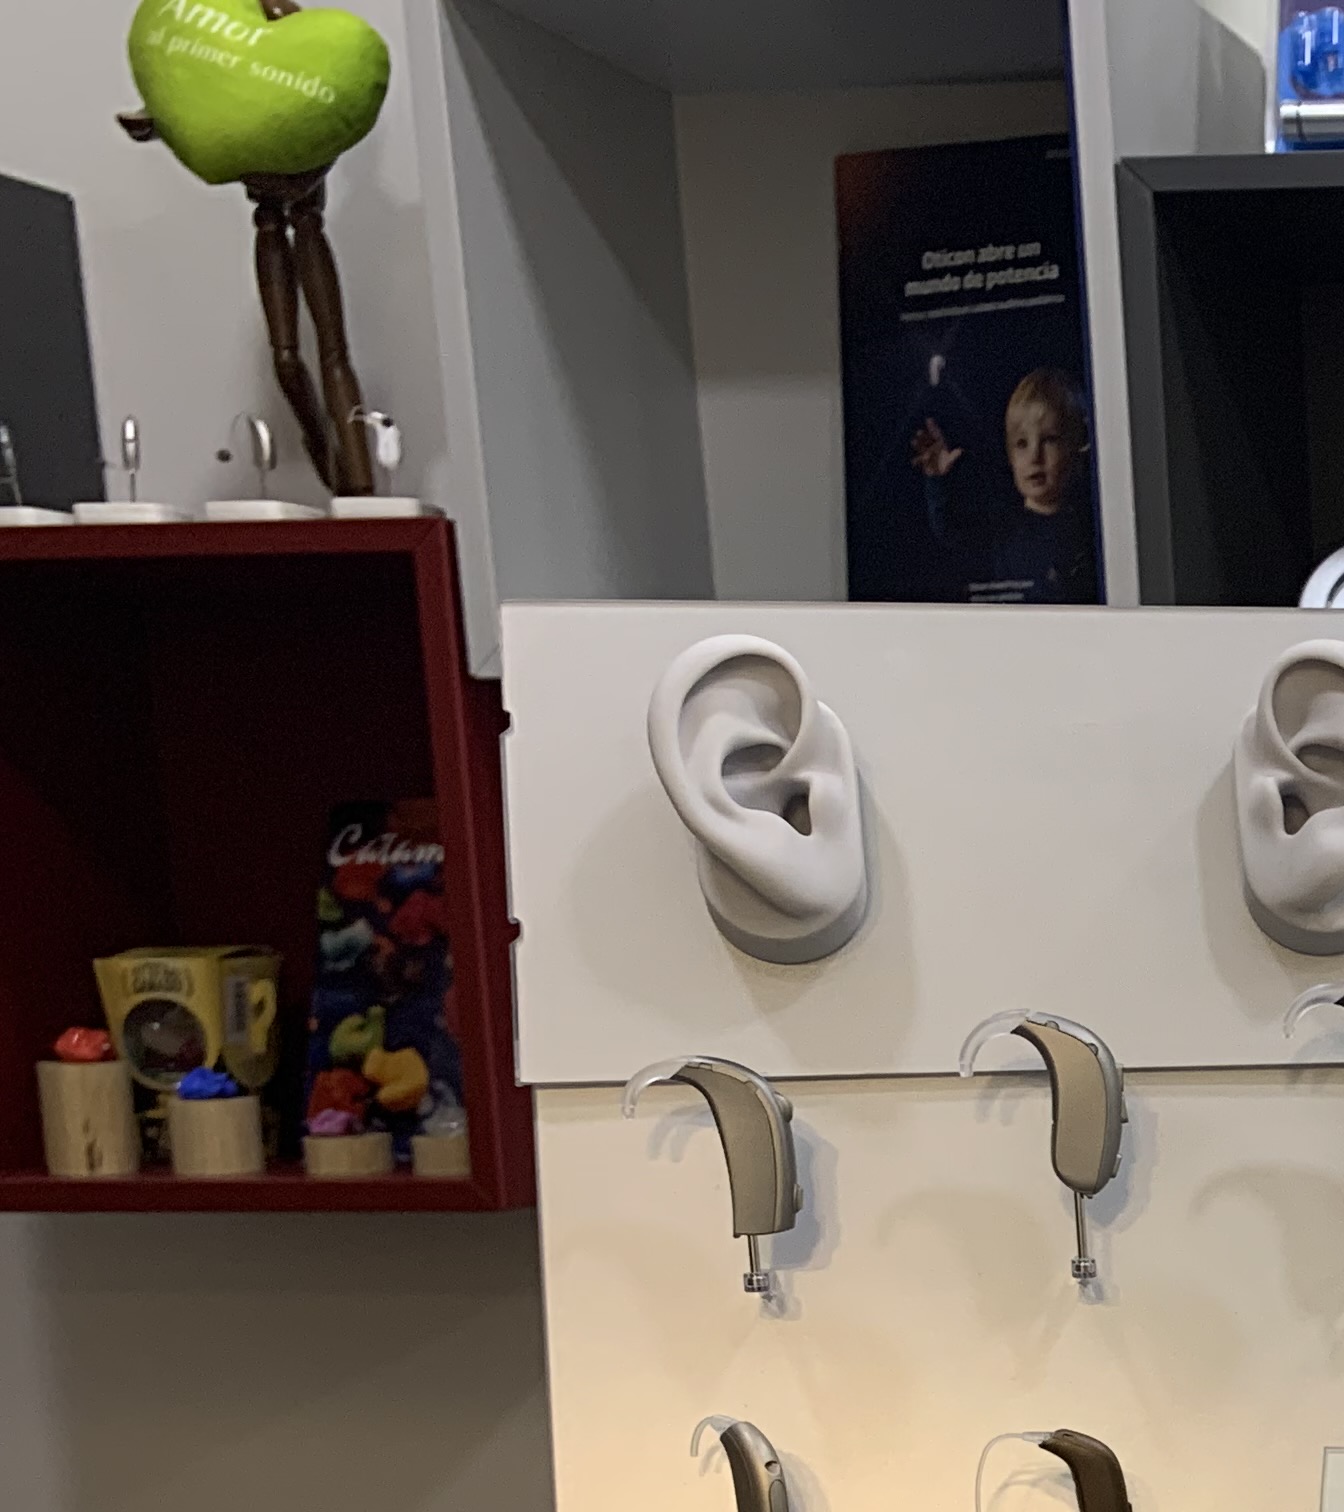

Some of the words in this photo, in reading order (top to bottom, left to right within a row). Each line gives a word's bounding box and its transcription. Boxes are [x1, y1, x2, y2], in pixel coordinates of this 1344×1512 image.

[156, 0, 273, 47] Amor
[166, 35, 242, 68] primer
[250, 61, 336, 104] sonido
